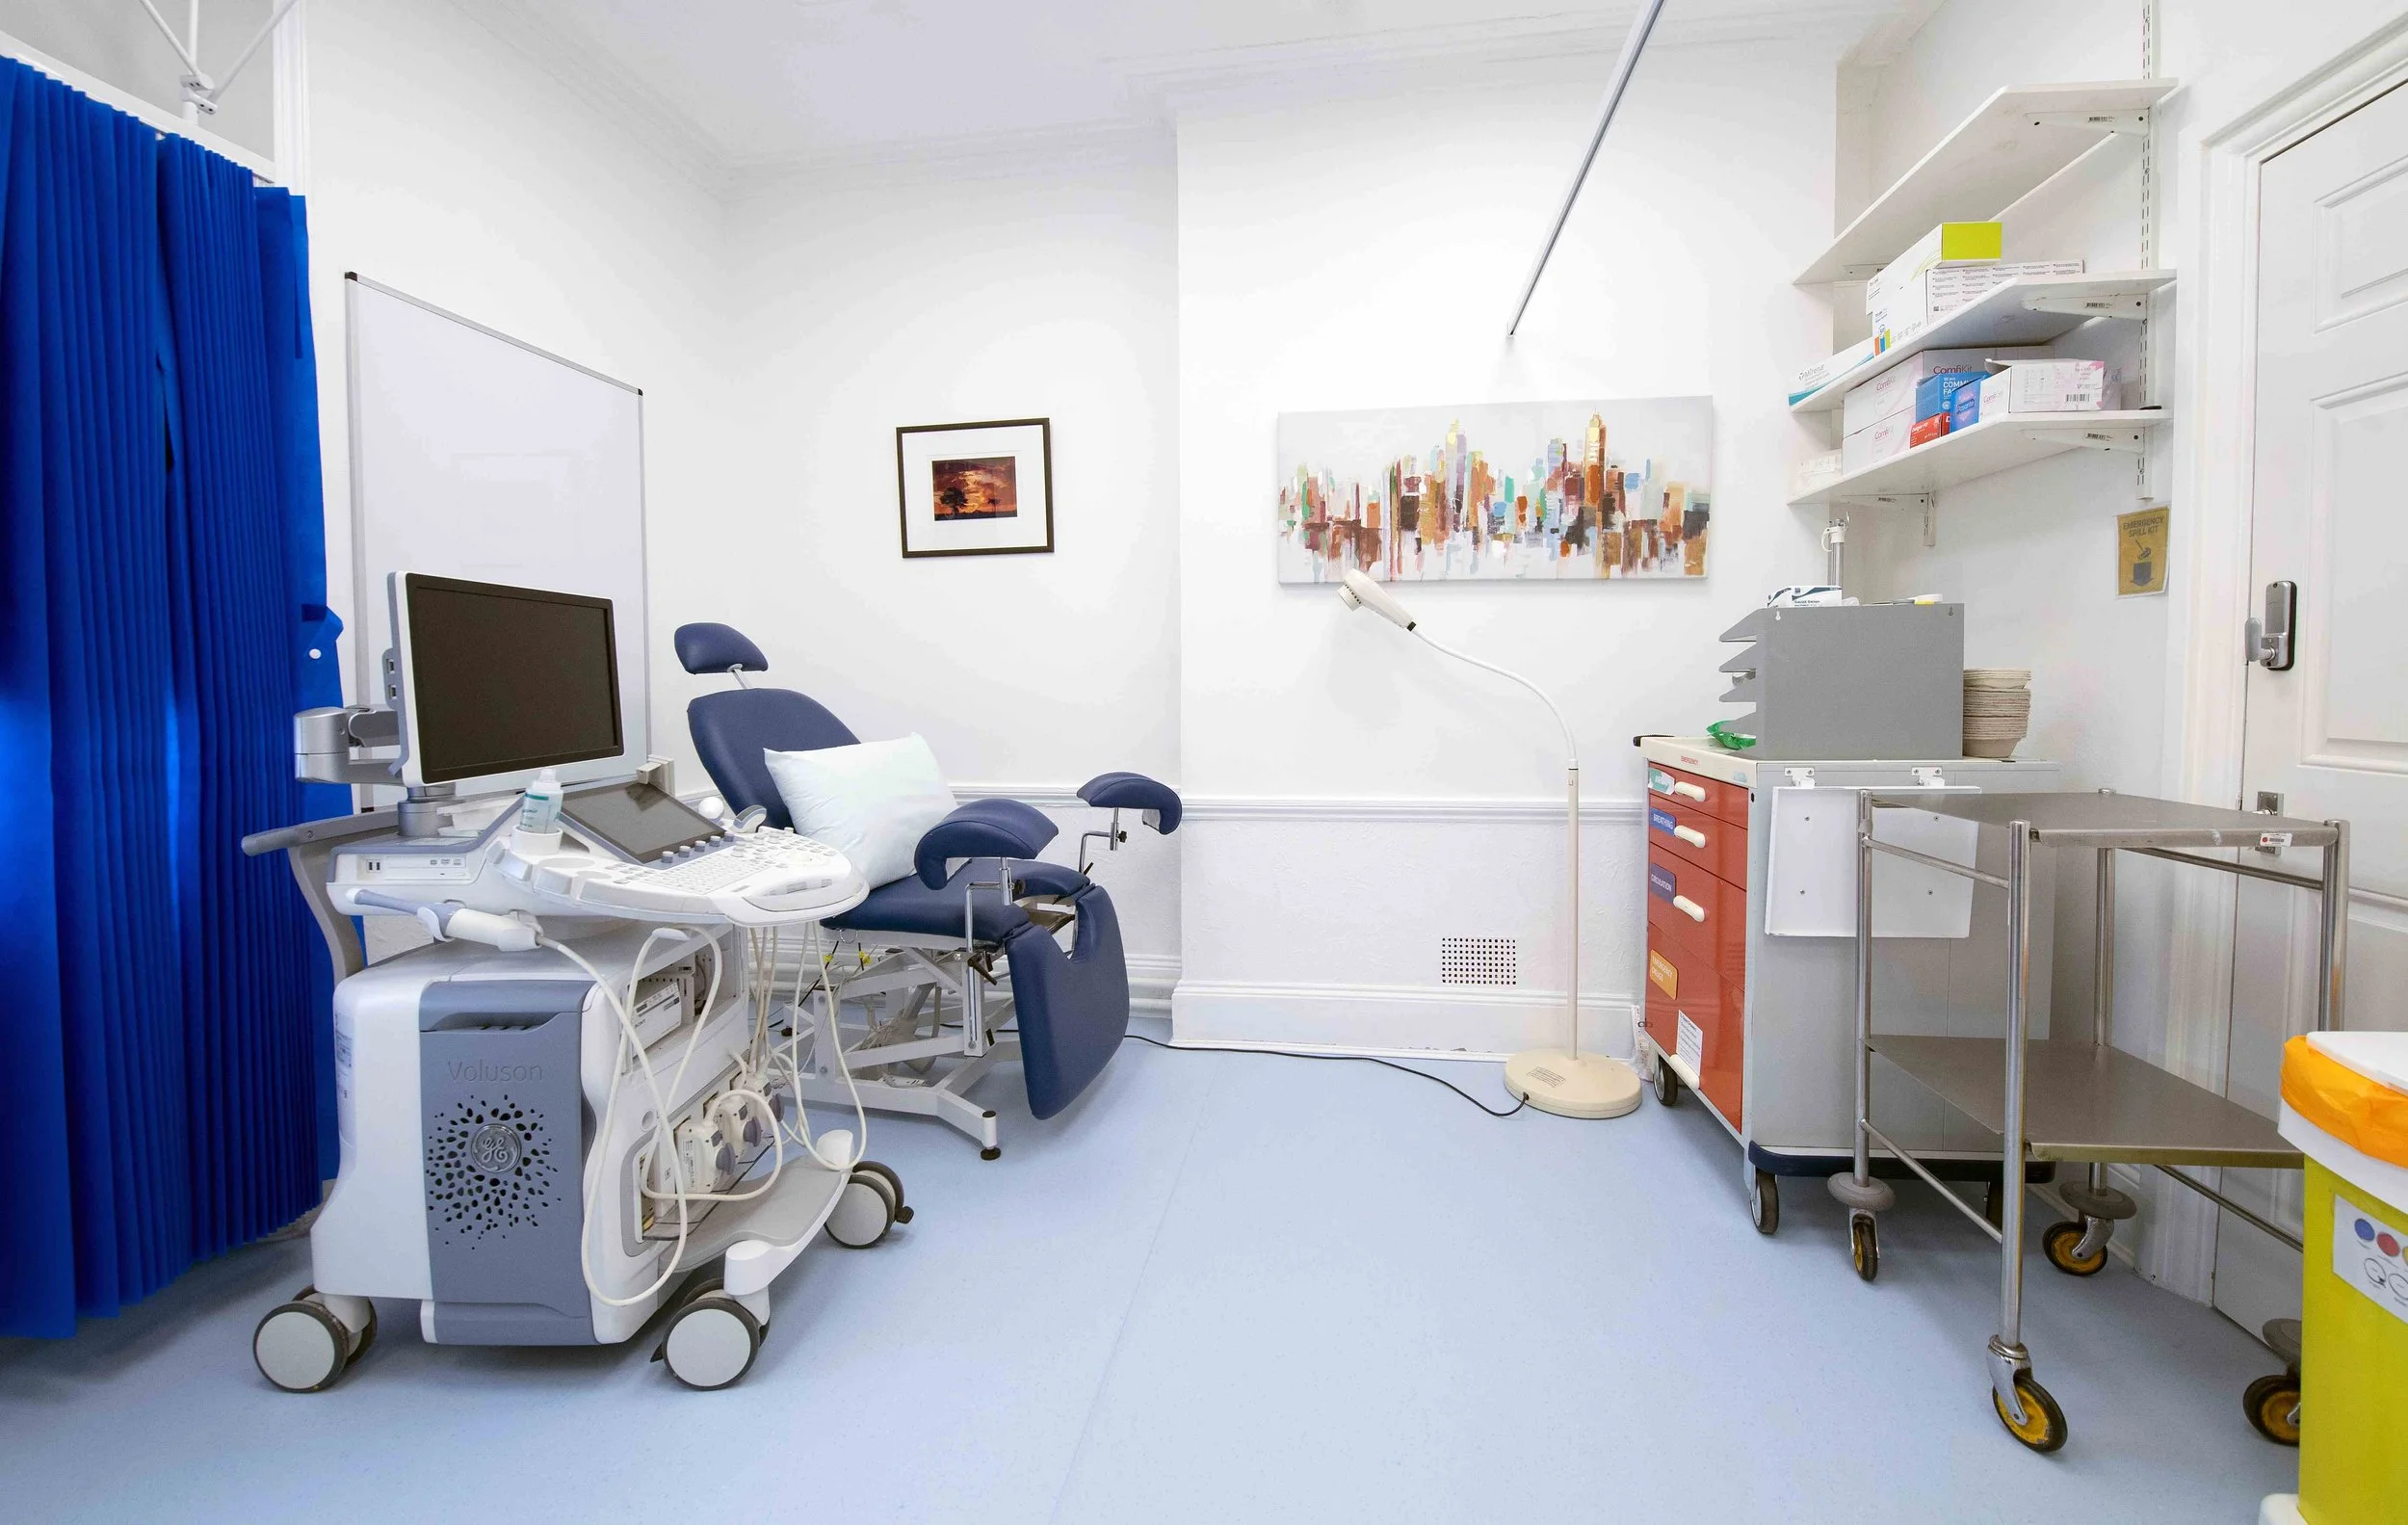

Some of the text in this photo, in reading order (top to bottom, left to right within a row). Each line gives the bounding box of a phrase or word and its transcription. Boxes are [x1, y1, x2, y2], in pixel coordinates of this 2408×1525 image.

[2124, 516, 2164, 530] EMERGENCY
[2129, 525, 2159, 538] SPILL KIT
[1653, 813, 1673, 829] BREATHING
[1651, 874, 1672, 892] CIRCULATION
[1652, 956, 1672, 979] EMERGENCY
[448, 1060, 542, 1081] Voluson
